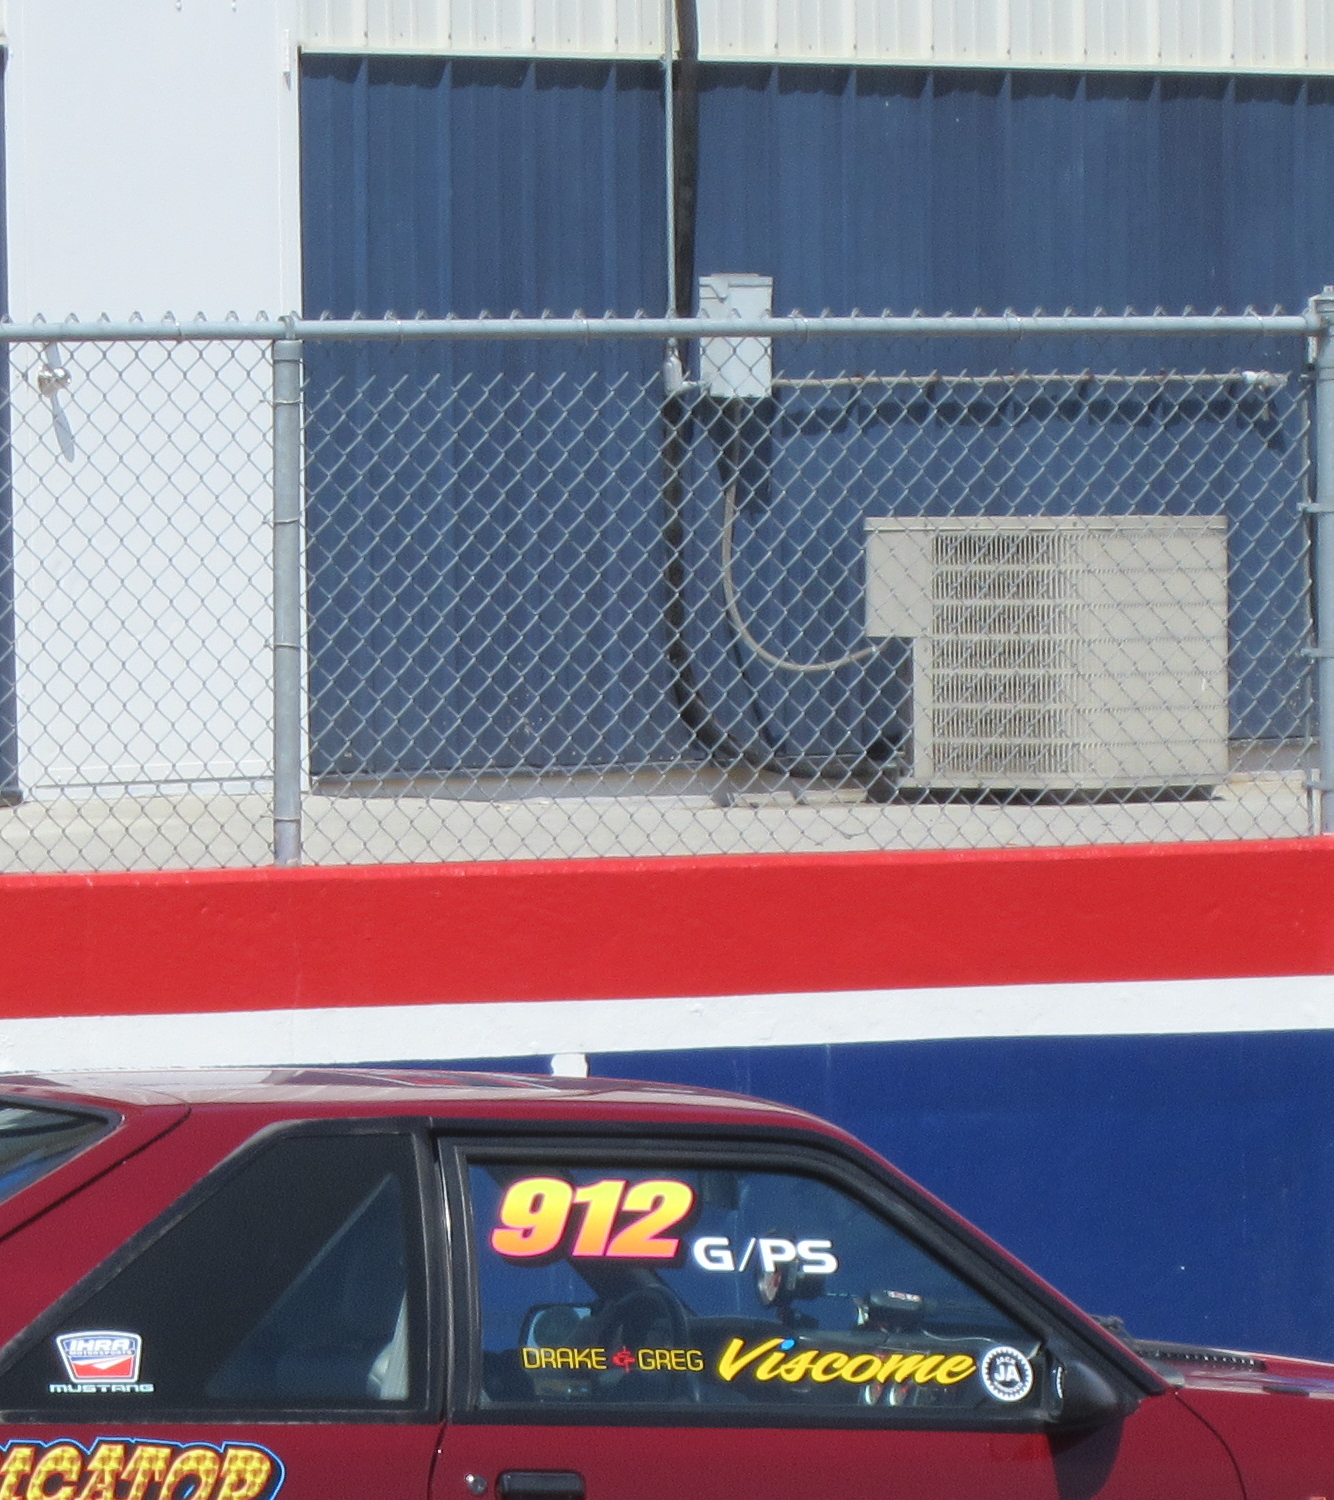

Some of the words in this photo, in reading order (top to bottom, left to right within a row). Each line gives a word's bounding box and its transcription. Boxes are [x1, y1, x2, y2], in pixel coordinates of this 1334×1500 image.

[491, 1176, 694, 1259] 912
[692, 1236, 839, 1275] G/PS
[69, 1339, 131, 1351] IHRA
[521, 1346, 607, 1371] DRAKE
[636, 1348, 704, 1372] GREG
[717, 1337, 977, 1385] Viscome
[993, 1364, 1022, 1382] JA
[49, 1384, 155, 1394] MUSTANG
